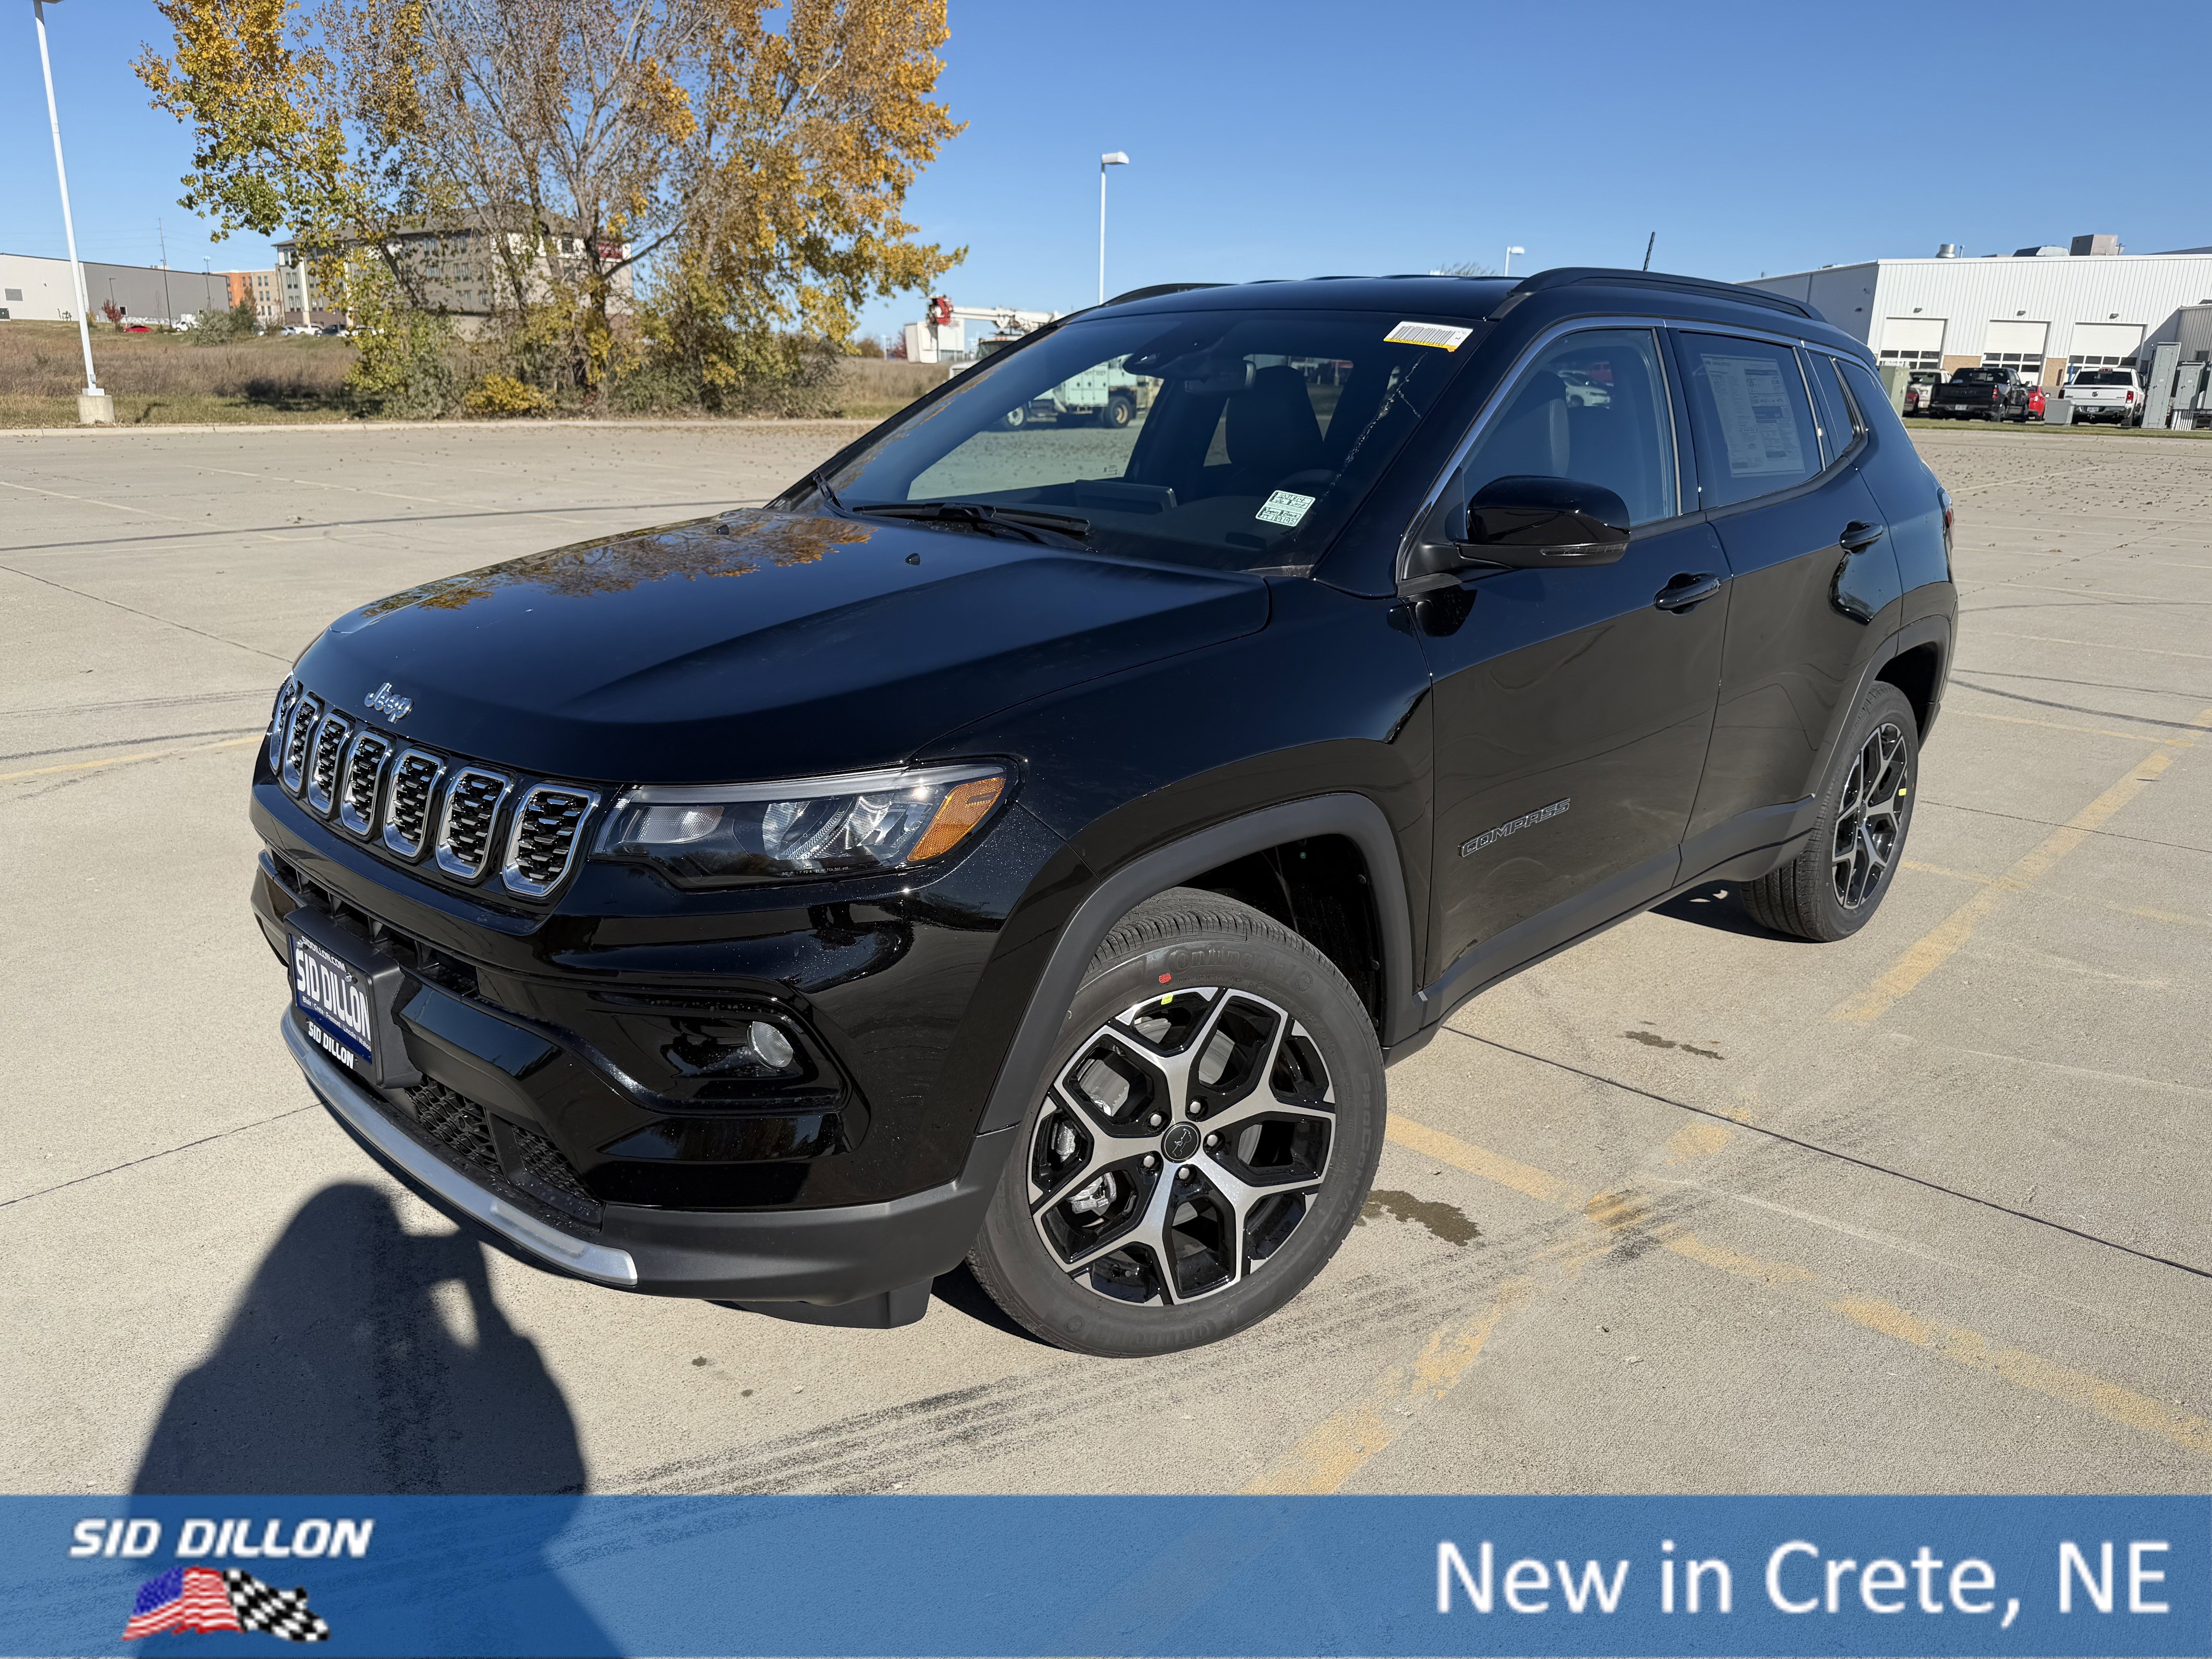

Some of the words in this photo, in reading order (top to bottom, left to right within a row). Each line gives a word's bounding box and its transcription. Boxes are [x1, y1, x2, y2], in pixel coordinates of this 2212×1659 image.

[364, 682, 413, 723] Jeep
[1459, 797, 1571, 857] COMPASS
[296, 948, 320, 1002] SID
[321, 965, 371, 1042] DILLON
[314, 1003, 324, 1015] Crete
[308, 1021, 322, 1043] SID
[323, 1032, 354, 1069] DILLON
